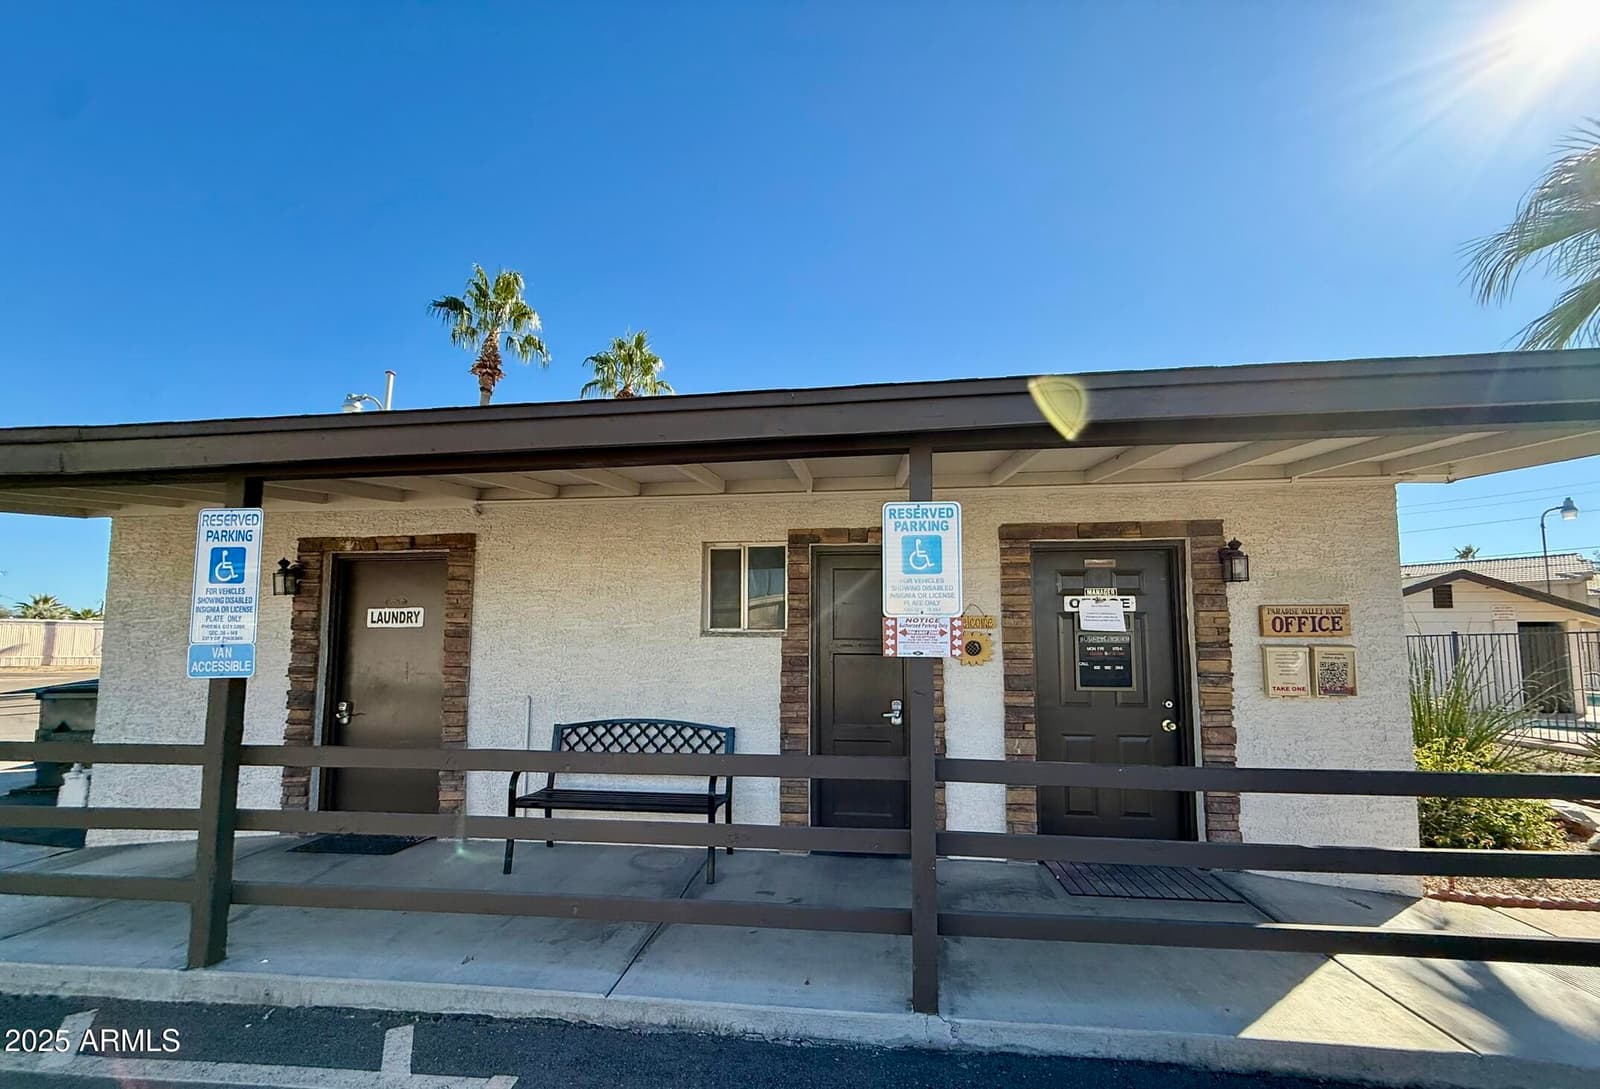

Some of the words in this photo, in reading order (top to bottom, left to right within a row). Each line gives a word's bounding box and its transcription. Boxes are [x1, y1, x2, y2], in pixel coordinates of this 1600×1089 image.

[889, 507, 954, 519] RESERVED
[201, 514, 259, 527] RESERVED
[894, 520, 949, 532] PARKING
[206, 530, 253, 542] PARKING
[219, 587, 246, 595] VEHICLES
[225, 596, 253, 604] DISABLED
[1267, 607, 1299, 615] PARADISE
[1300, 607, 1323, 615] VALLEY
[370, 611, 420, 624] LAUNDRY
[963, 616, 993, 629] elcome
[1271, 616, 1343, 633] OFFICE
[212, 647, 232, 658] VAN
[191, 660, 251, 673] ACCESSIBLE
